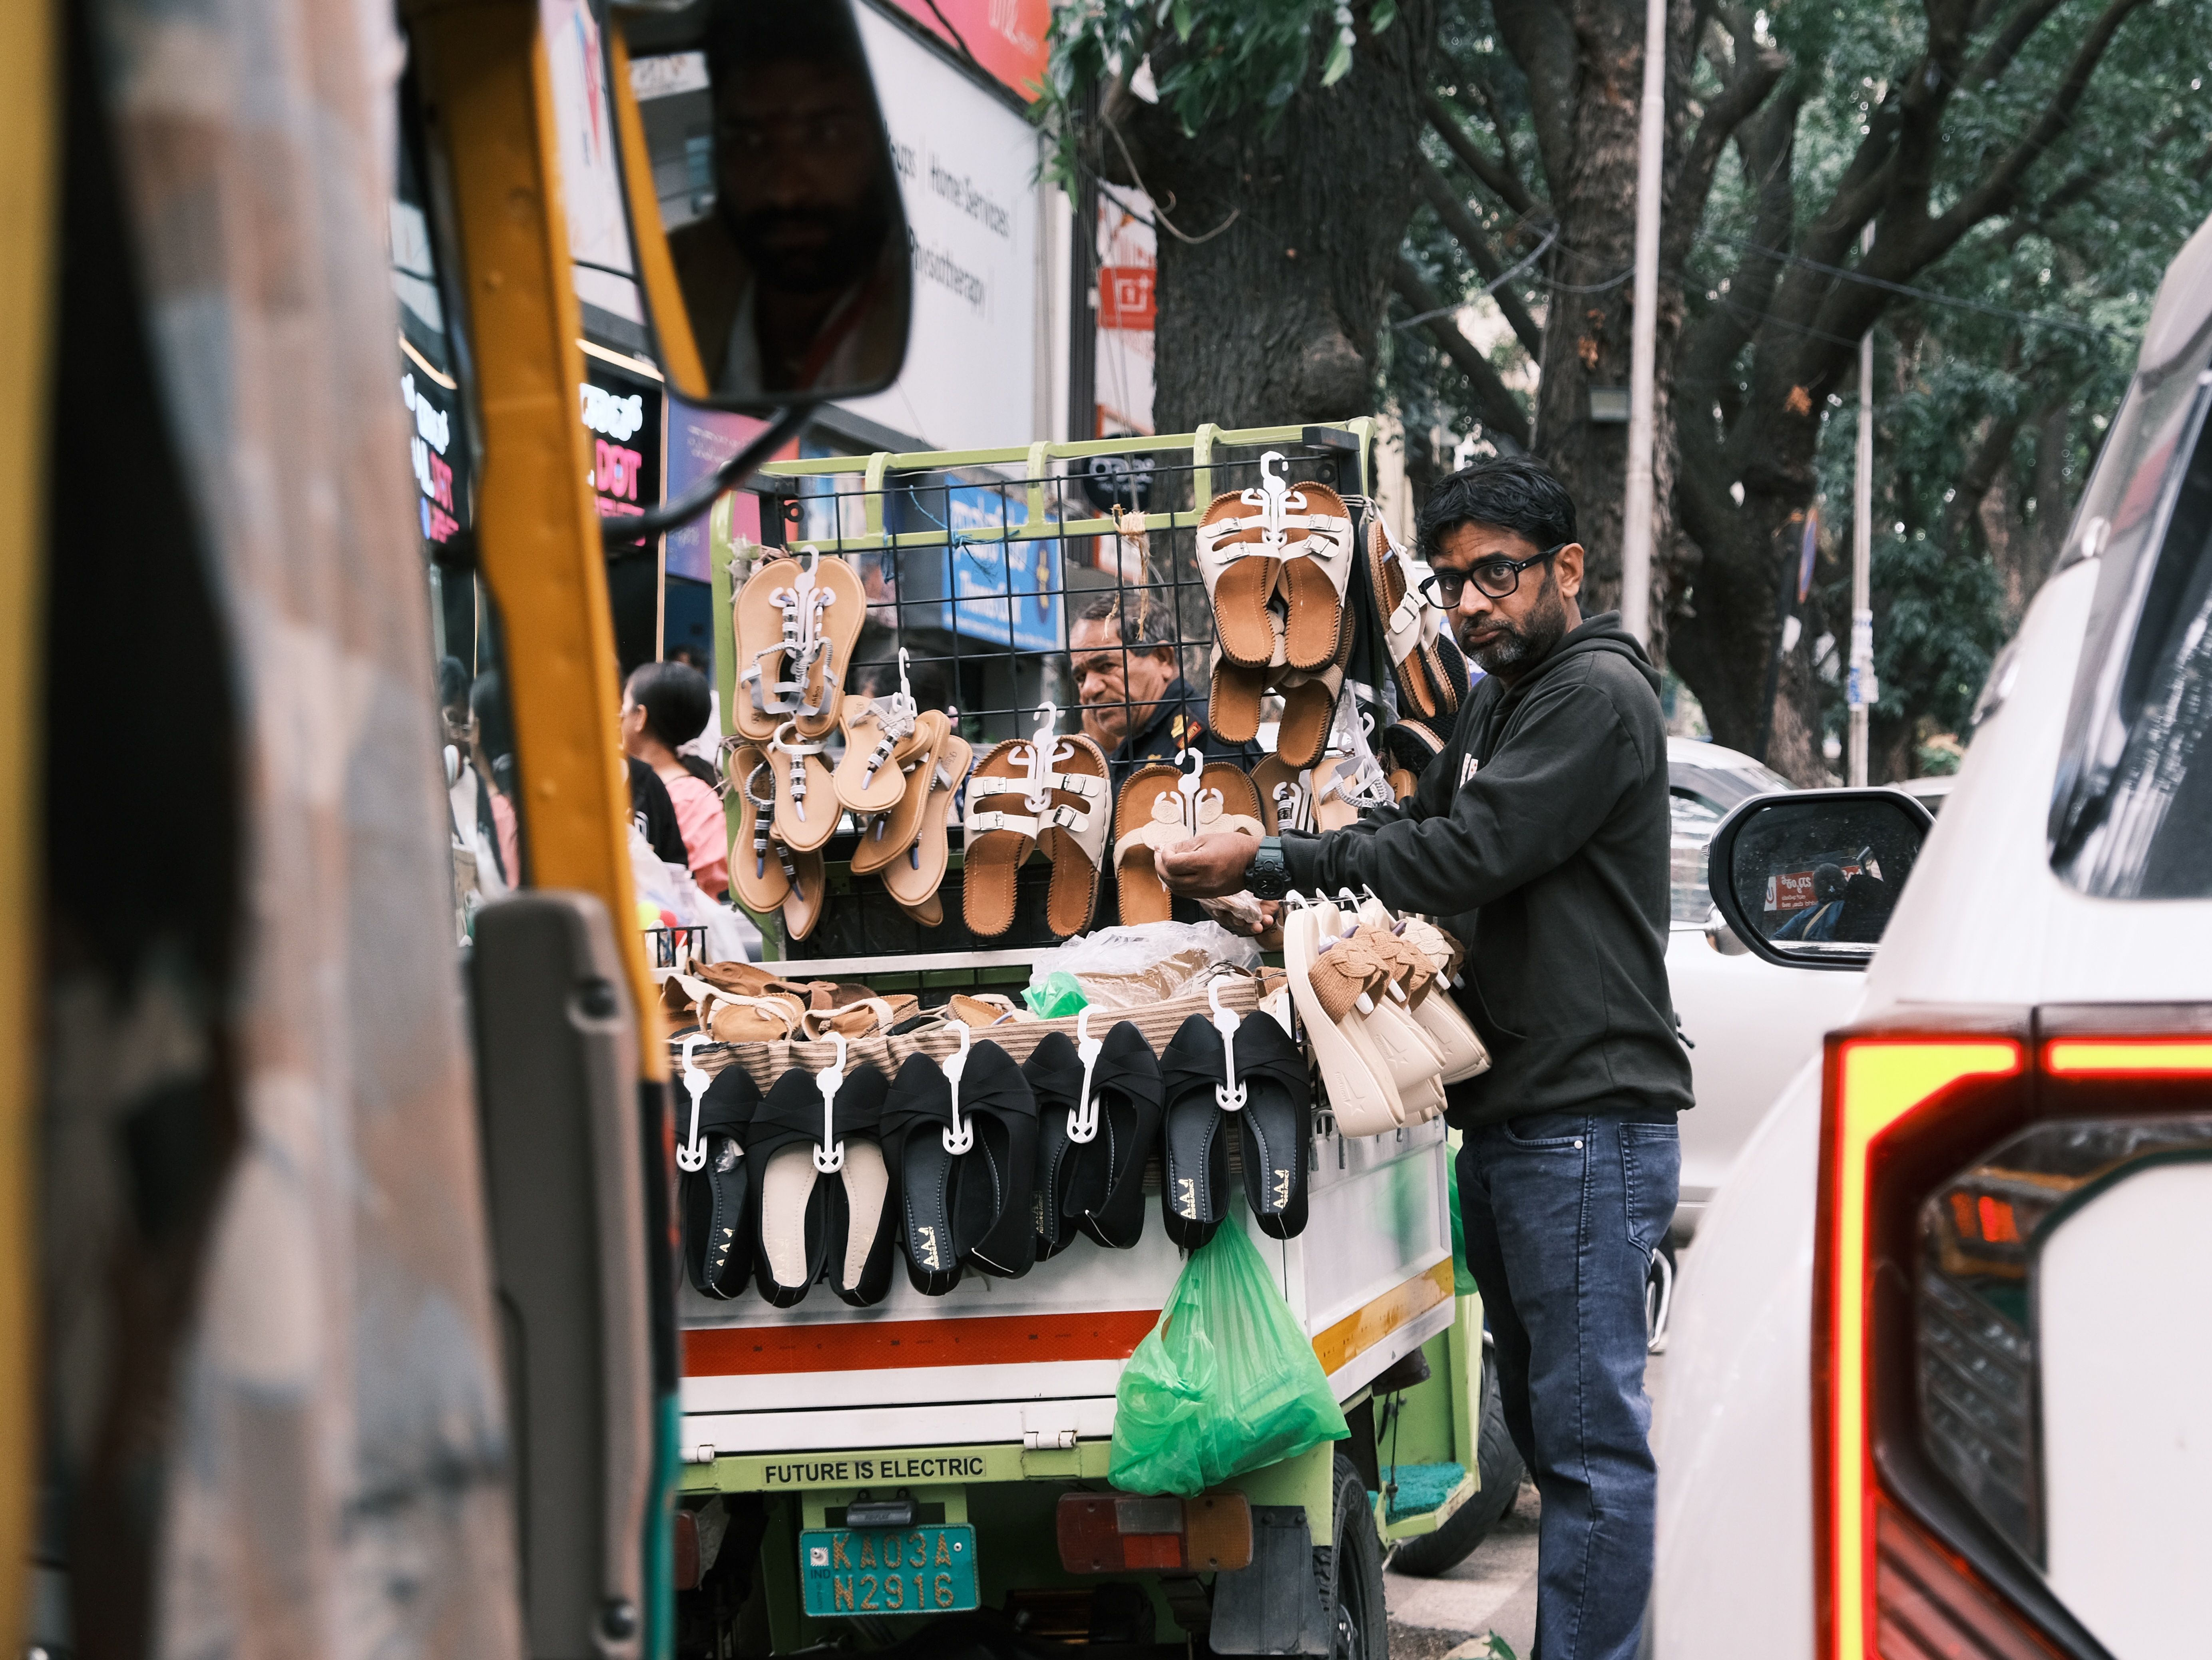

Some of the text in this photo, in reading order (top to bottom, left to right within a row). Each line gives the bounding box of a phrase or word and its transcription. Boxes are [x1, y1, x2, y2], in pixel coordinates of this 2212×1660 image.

[766, 1457, 983, 1484] FUTURE IS ELECTRIC
[832, 1532, 952, 1570] KA03A
[810, 1569, 830, 1579] IND
[834, 1572, 954, 1611] N2916
